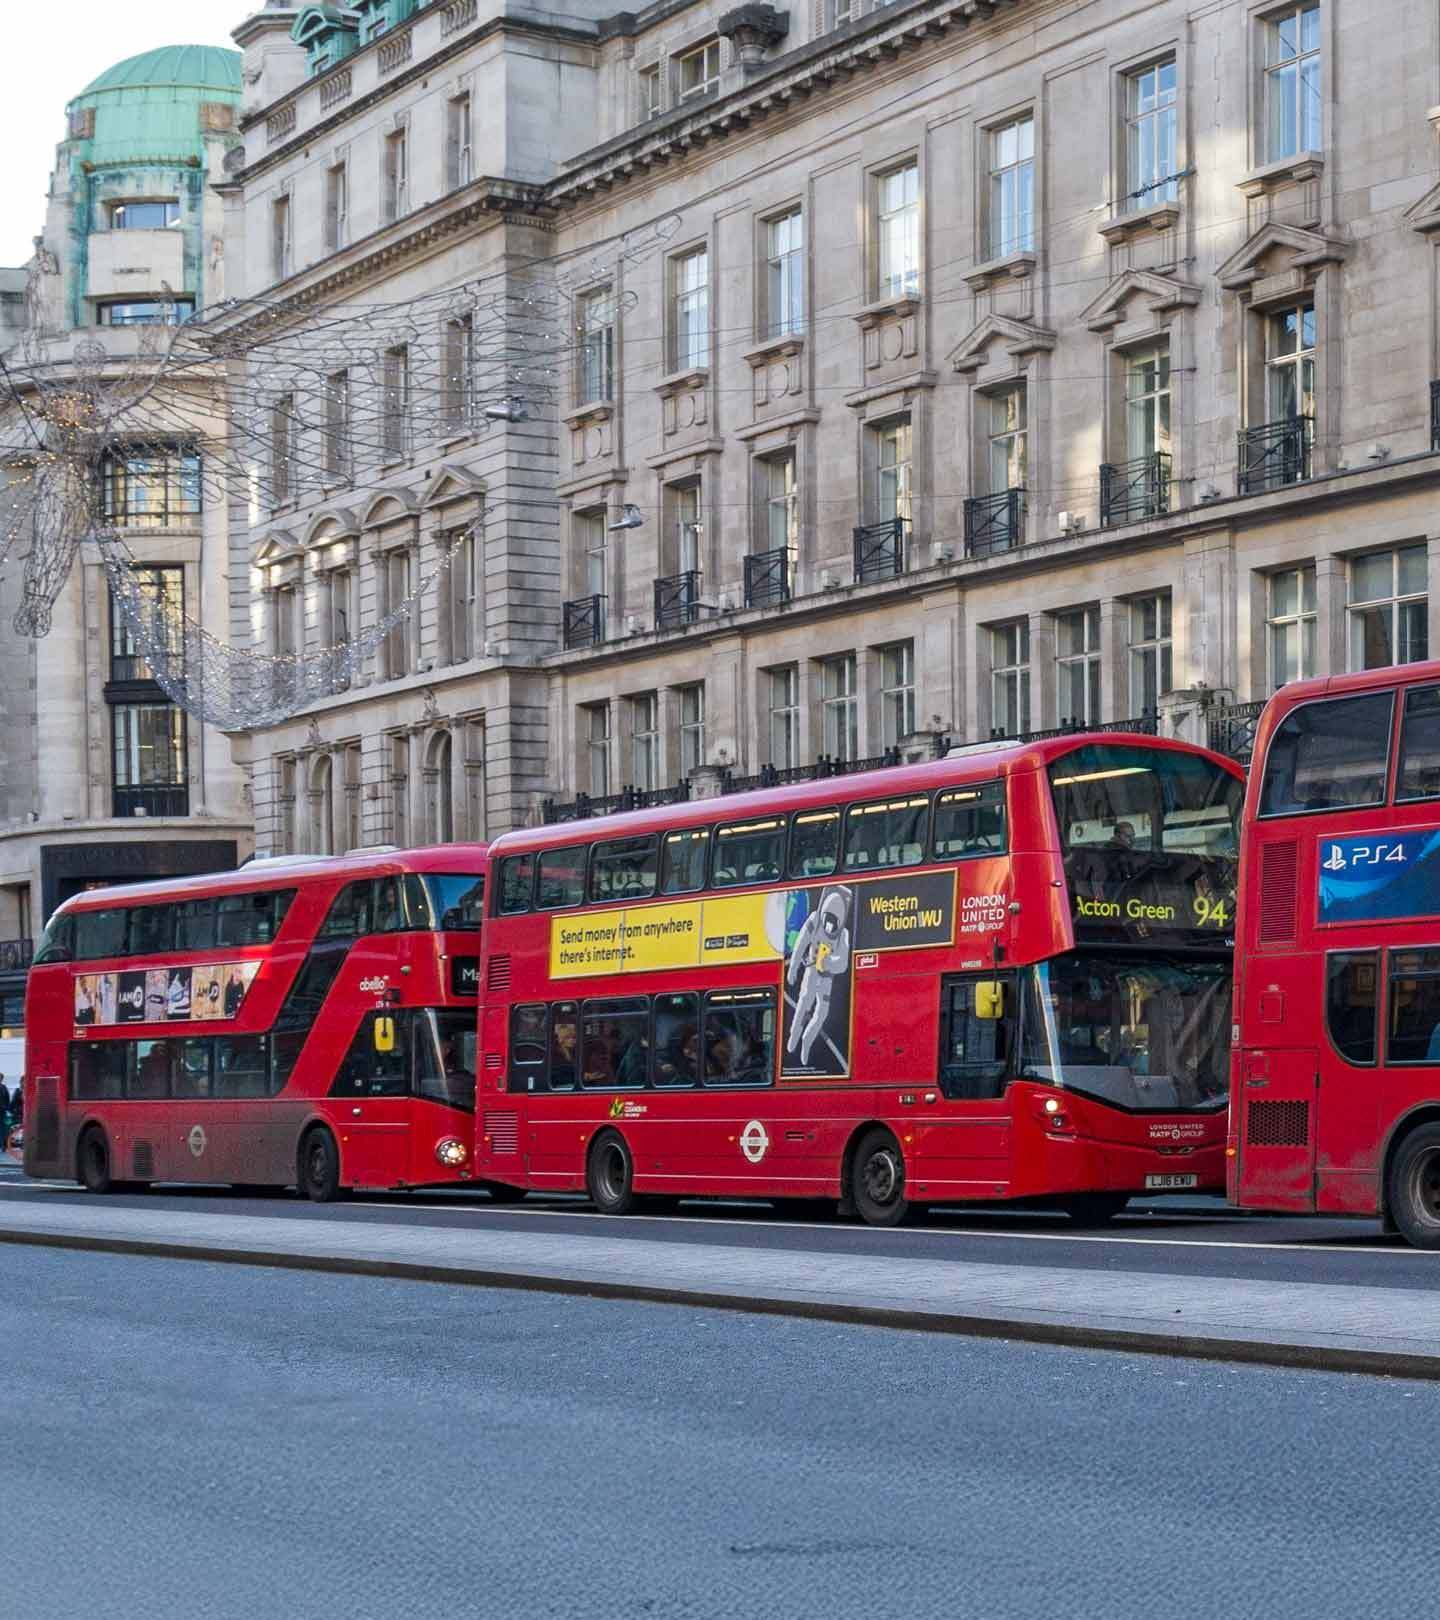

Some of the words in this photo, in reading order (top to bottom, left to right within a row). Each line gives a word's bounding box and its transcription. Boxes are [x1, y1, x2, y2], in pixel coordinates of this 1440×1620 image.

[1351, 843, 1408, 866] PS4
[870, 896, 918, 914] Western
[962, 894, 1006, 909] LONDON
[1126, 898, 1174, 919] Green
[884, 911, 917, 931] Union
[921, 909, 943, 928] WU
[961, 908, 1005, 923] UNITED
[1193, 896, 1228, 928] 94
[560, 927, 583, 945] Send
[585, 926, 617, 944] money
[618, 922, 642, 940] from
[644, 917, 693, 939] anywhere
[560, 948, 592, 964] there's
[593, 944, 635, 962] internet.
[1150, 1130, 1170, 1138] RATP
[1181, 1130, 1204, 1138] GROUP
